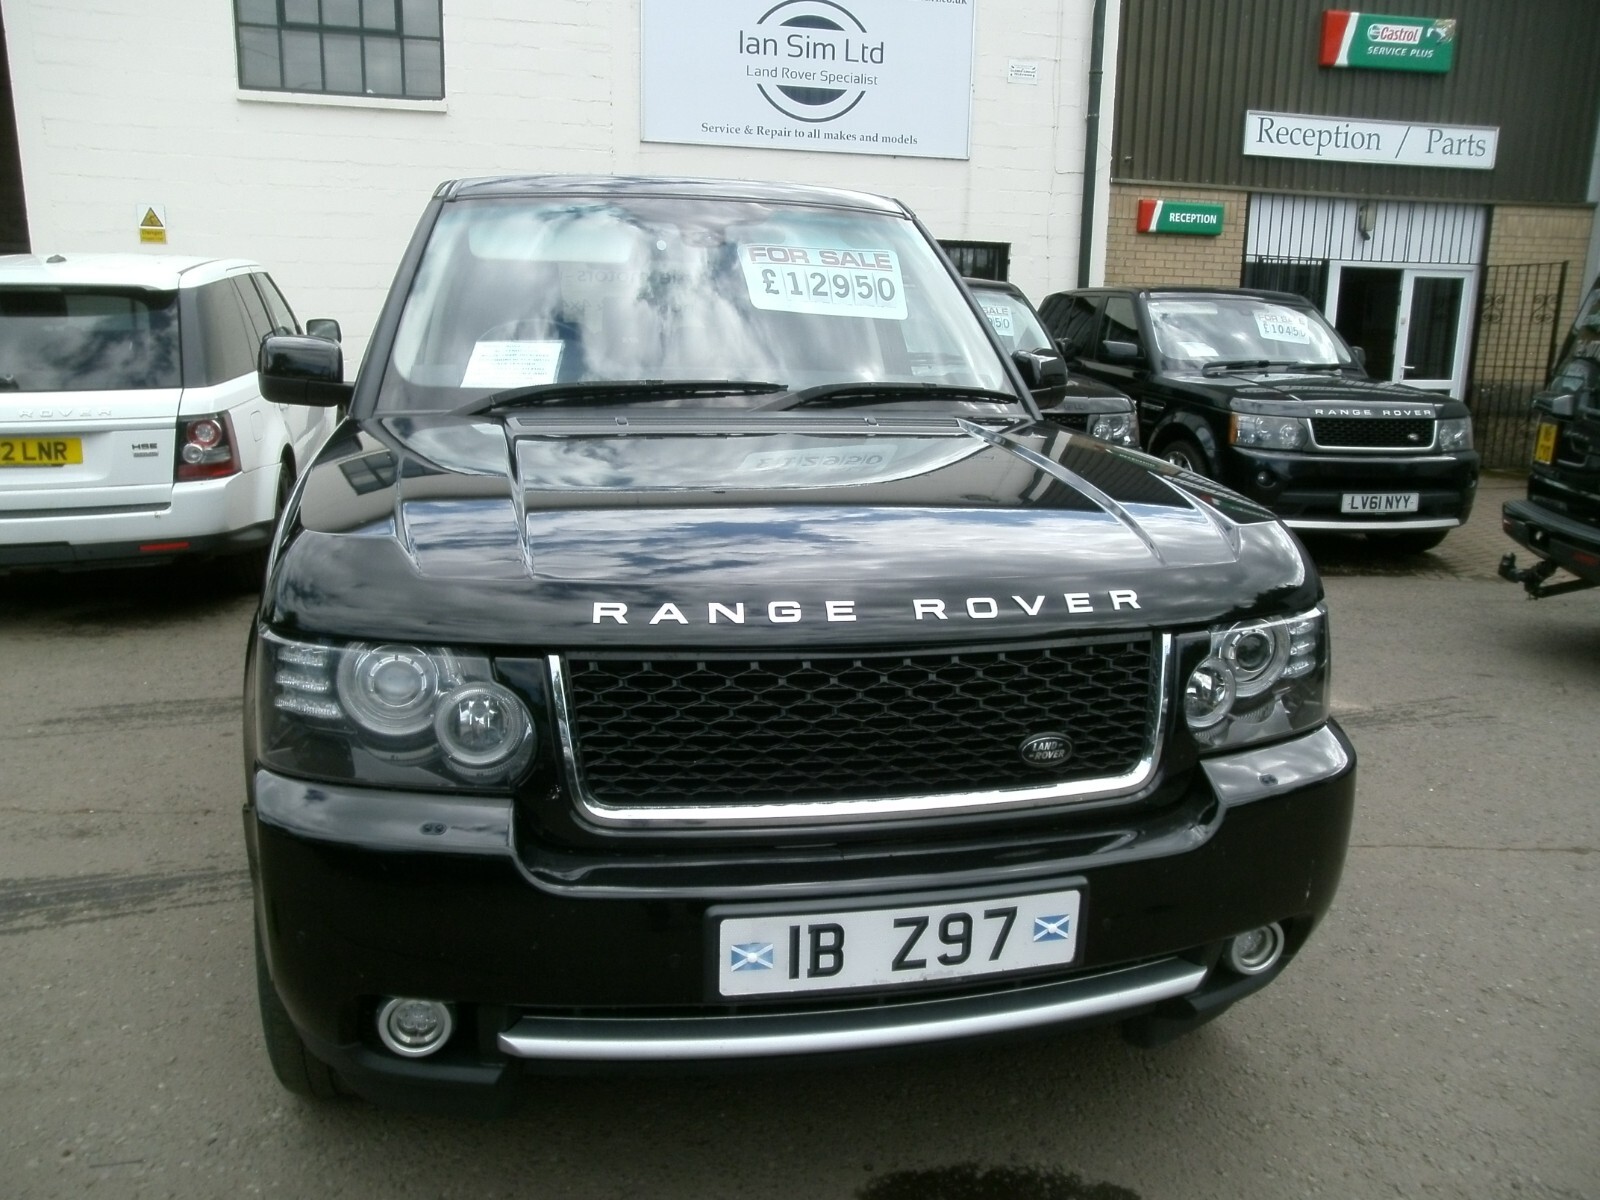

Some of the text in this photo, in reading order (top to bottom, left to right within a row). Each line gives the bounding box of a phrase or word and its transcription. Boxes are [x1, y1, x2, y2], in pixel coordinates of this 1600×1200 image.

[1380, 26, 1418, 42] Castrol
[739, 30, 885, 64] Ian Sim Ltd
[1367, 45, 1435, 58] SERVICE PLUS
[746, 65, 878, 85] Land Rover Specialist
[701, 122, 918, 145] Service & Repair to all makes and models
[1255, 117, 1382, 156] Reception
[1425, 129, 1487, 157] Parts
[1169, 212, 1217, 225] RECEPTION
[748, 247, 892, 269] FOR SALE
[761, 268, 895, 301] £12950
[18, 408, 112, 418] ROVER
[1314, 408, 1372, 416] RANGE
[22, 441, 67, 461] LNR
[1350, 495, 1411, 510] LV61 NYY
[593, 589, 1142, 625] RANGE ROVER
[891, 905, 1018, 972] Z97
